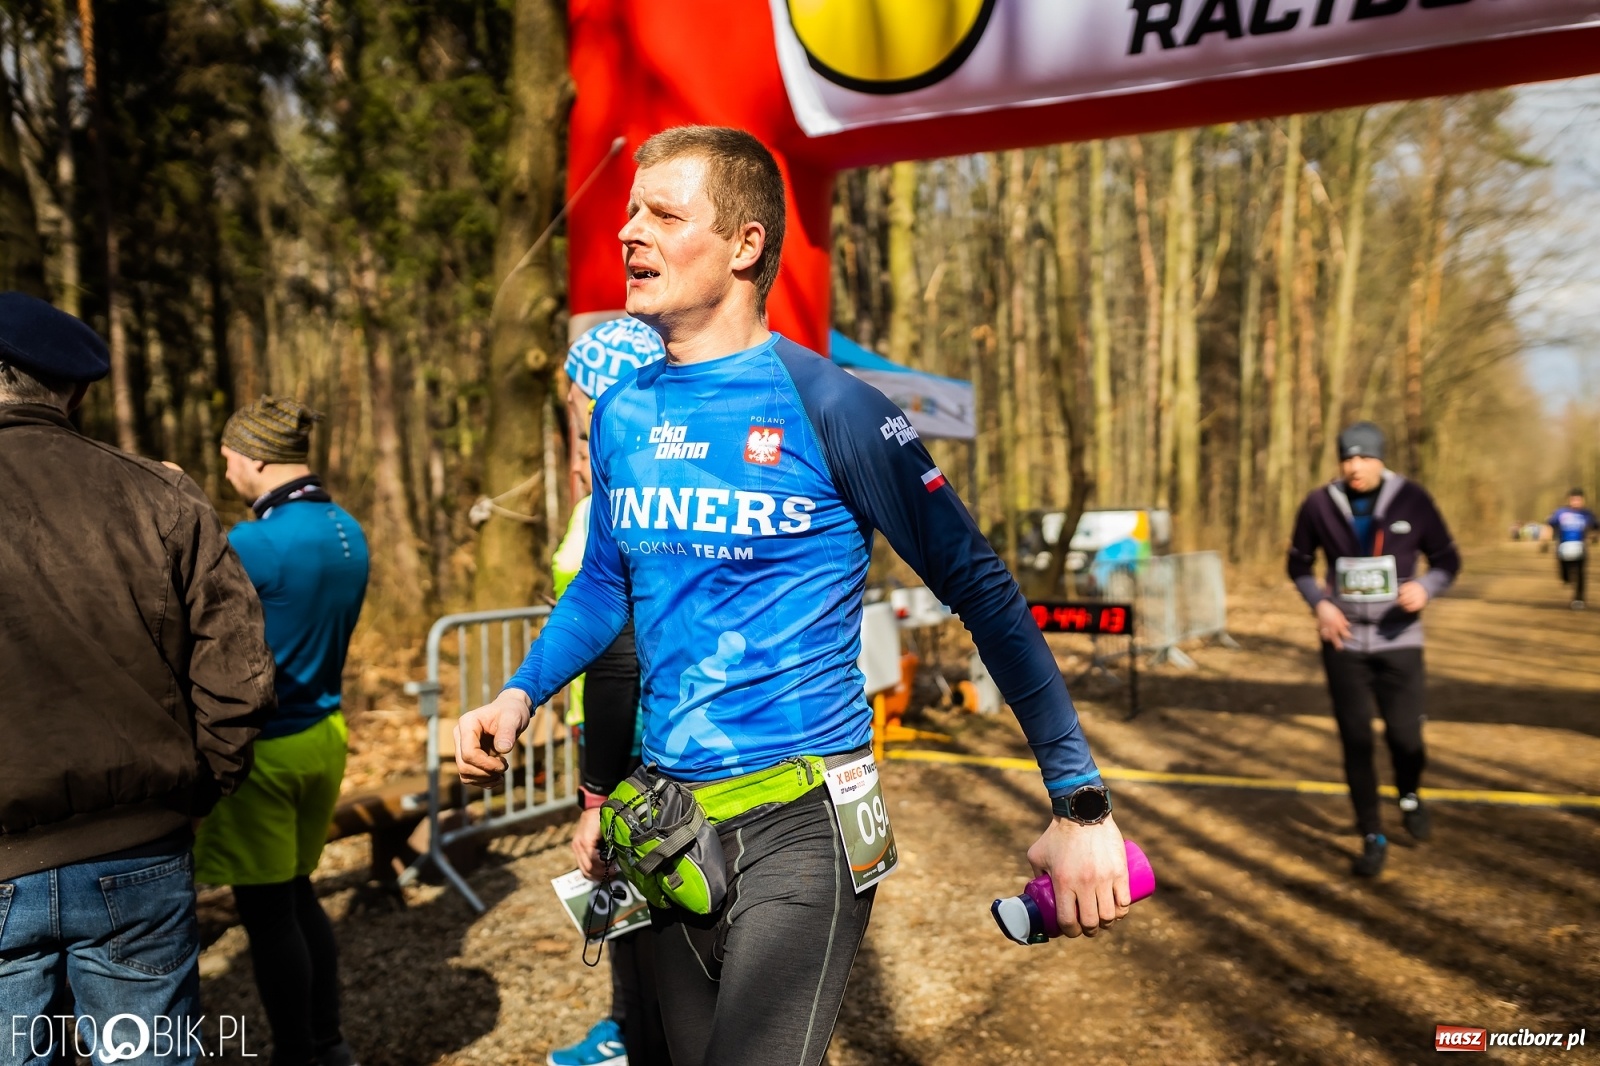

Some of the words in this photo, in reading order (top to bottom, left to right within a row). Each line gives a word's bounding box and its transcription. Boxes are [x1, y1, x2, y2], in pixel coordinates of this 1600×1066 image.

[750, 415, 786, 425] POLAND
[654, 442, 710, 460] okna
[692, 544, 753, 560] TEAM
[836, 773, 844, 785] X
[844, 766, 863, 783] BIEG
